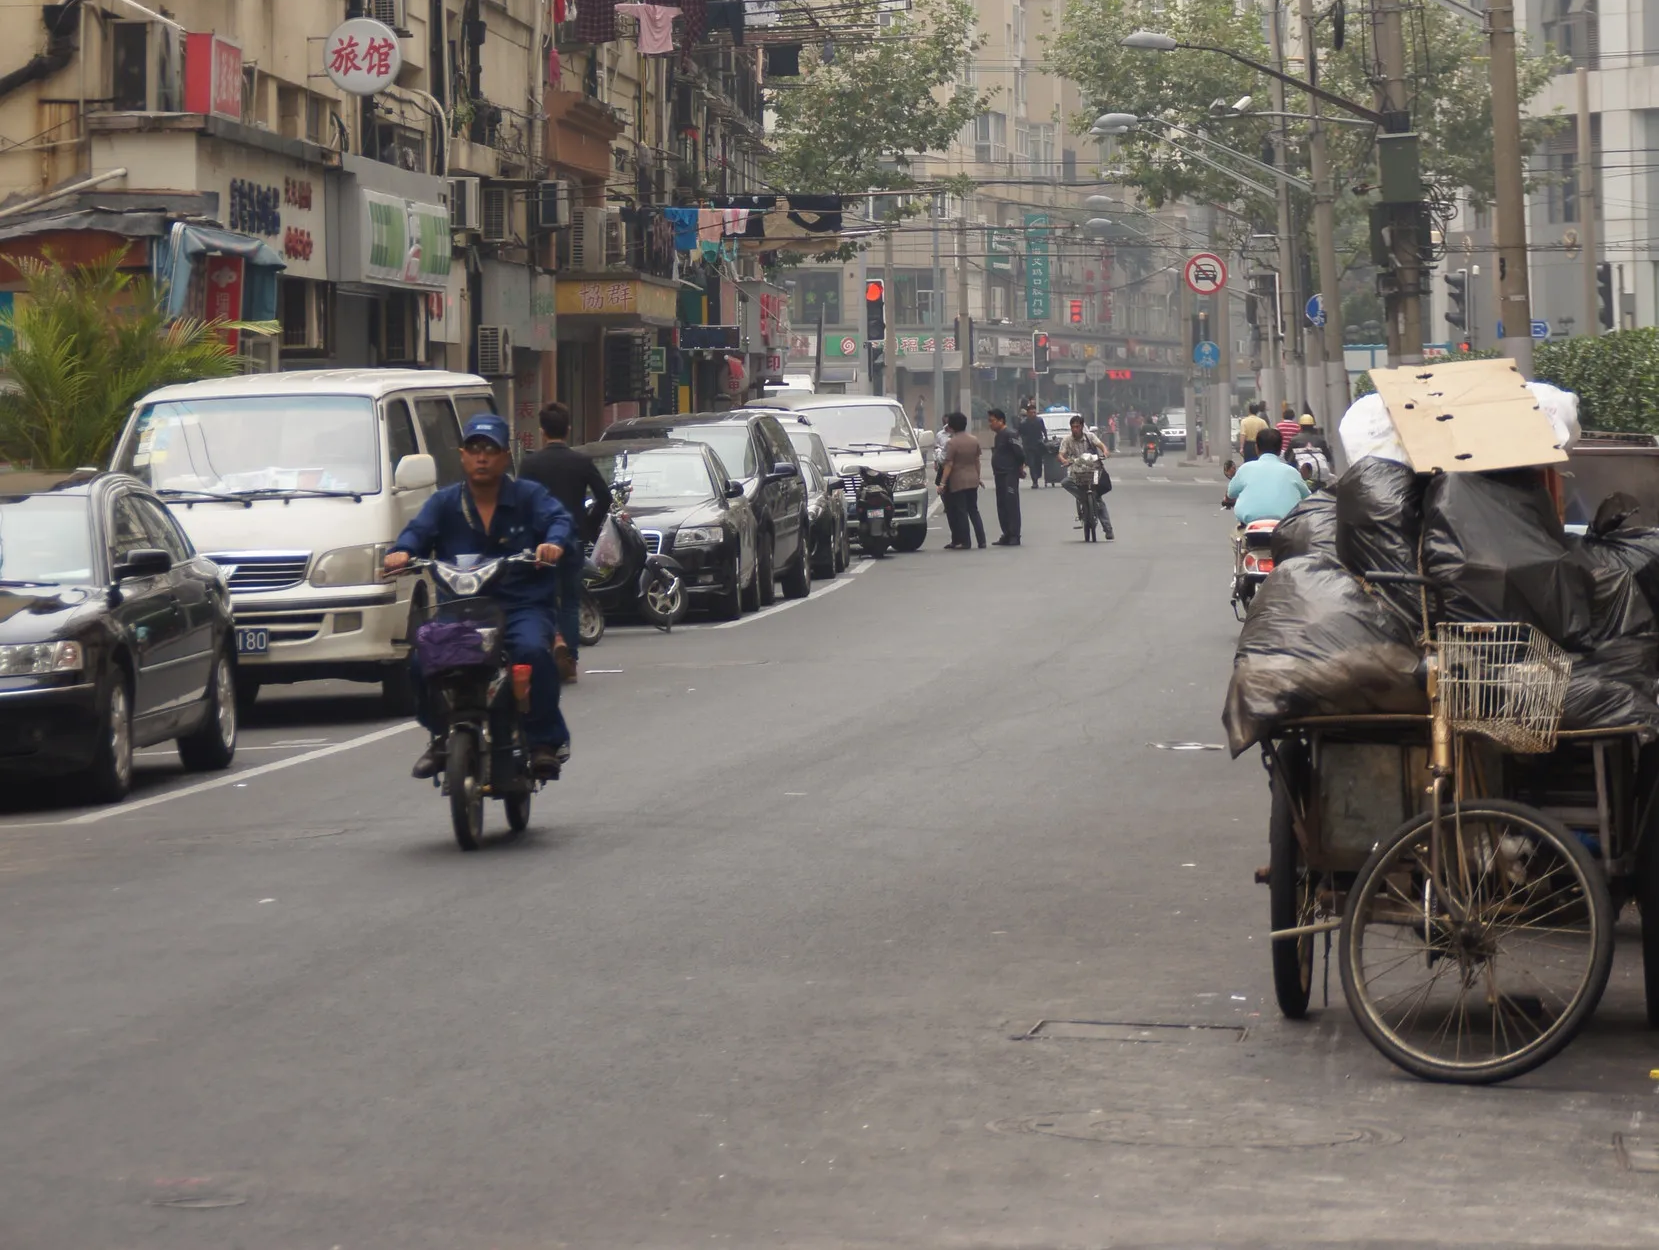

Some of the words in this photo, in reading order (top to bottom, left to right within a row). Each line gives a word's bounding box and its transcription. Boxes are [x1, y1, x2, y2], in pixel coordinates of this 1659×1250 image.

[329, 34, 395, 78] 旅馆
[579, 282, 633, 311] 協群
[1031, 238, 1044, 316] 艾玛口腔门诊
